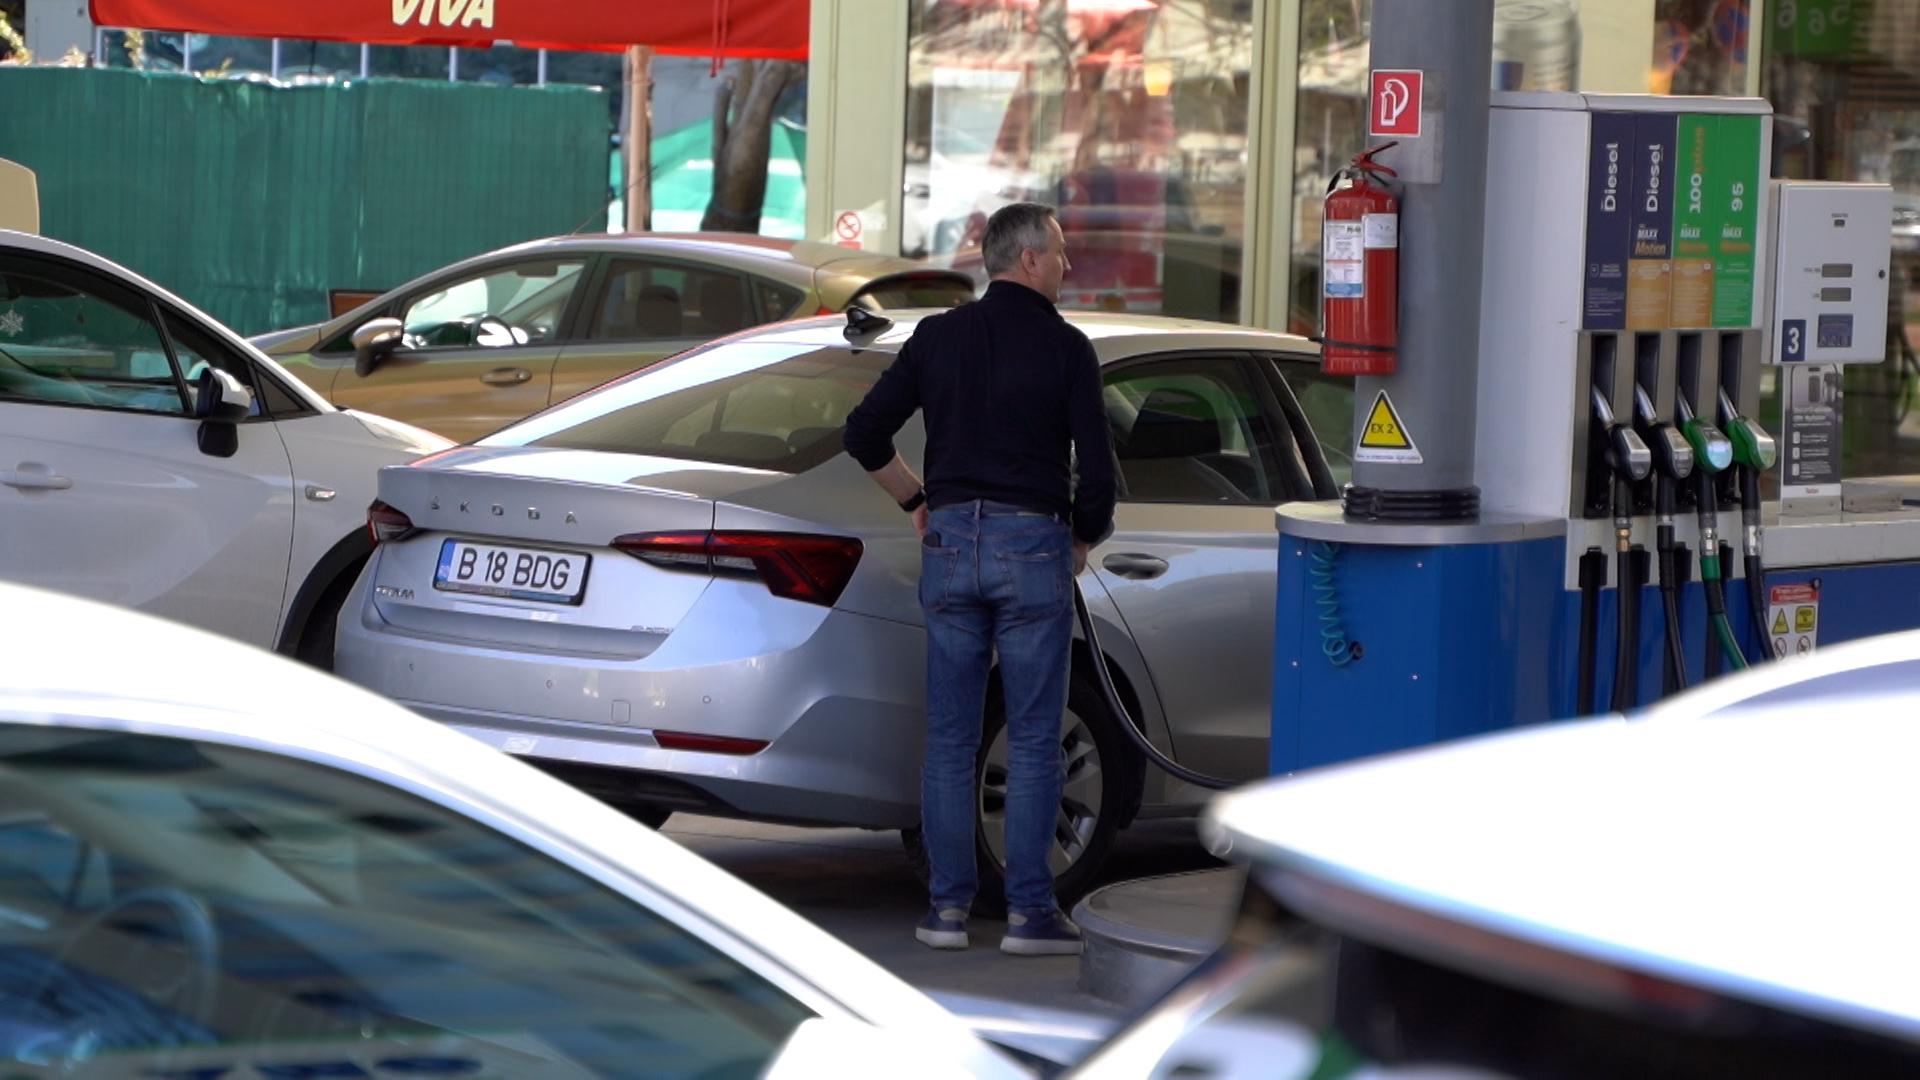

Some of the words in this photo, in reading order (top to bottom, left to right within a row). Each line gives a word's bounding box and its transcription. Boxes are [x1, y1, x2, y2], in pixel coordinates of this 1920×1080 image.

[392, 0, 494, 28] VIVA
[1604, 143, 1618, 211] Diesel
[1646, 144, 1660, 212] Diesel
[1731, 182, 1744, 212] 95
[1788, 327, 1800, 354] 3
[1371, 423, 1384, 434] EX
[1387, 424, 1394, 434] 2
[457, 547, 478, 580] B
[485, 550, 508, 583] 18
[512, 553, 570, 590] BDG
